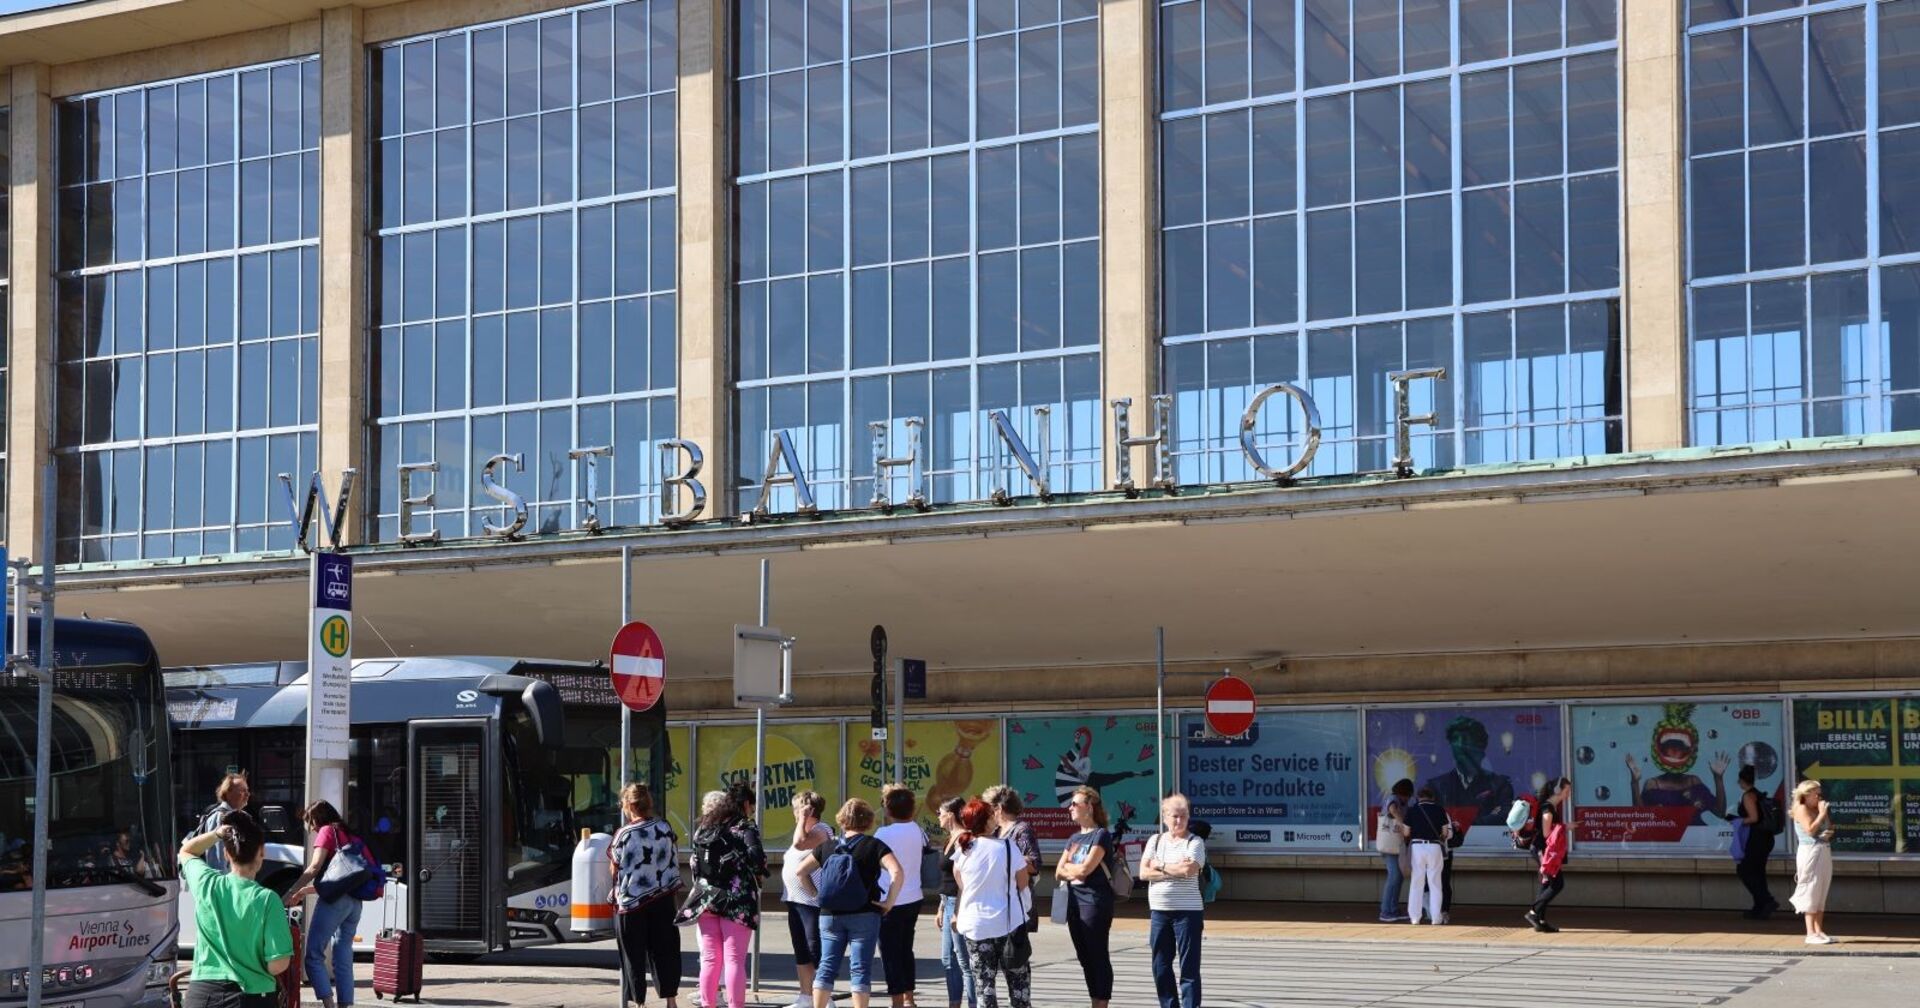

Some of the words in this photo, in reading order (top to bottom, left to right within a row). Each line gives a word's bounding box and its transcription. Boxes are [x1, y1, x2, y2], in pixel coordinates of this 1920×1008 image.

[278, 366, 1447, 552] WESTBAHNHOF
[329, 622, 346, 649] H
[1817, 709, 1886, 730] BILLA
[1800, 741, 1887, 751] UNTERGESCHOSS
[1828, 733, 1863, 741] EBENE
[1865, 733, 1877, 741] U1
[860, 755, 931, 780] BOMEN
[1187, 755, 1245, 772] Bester
[1251, 753, 1320, 772] Service
[1325, 752, 1352, 771] für
[720, 758, 816, 793] SCHRTNER
[1187, 779, 1236, 797] beste
[1242, 777, 1326, 797] Produkte
[1193, 806, 1227, 816] Cyberport
[1228, 806, 1246, 815] Store
[1265, 806, 1283, 815] Wien
[1238, 832, 1269, 840] Lenovo
[1296, 832, 1331, 841] Microsoft
[79, 920, 120, 935] Vienna
